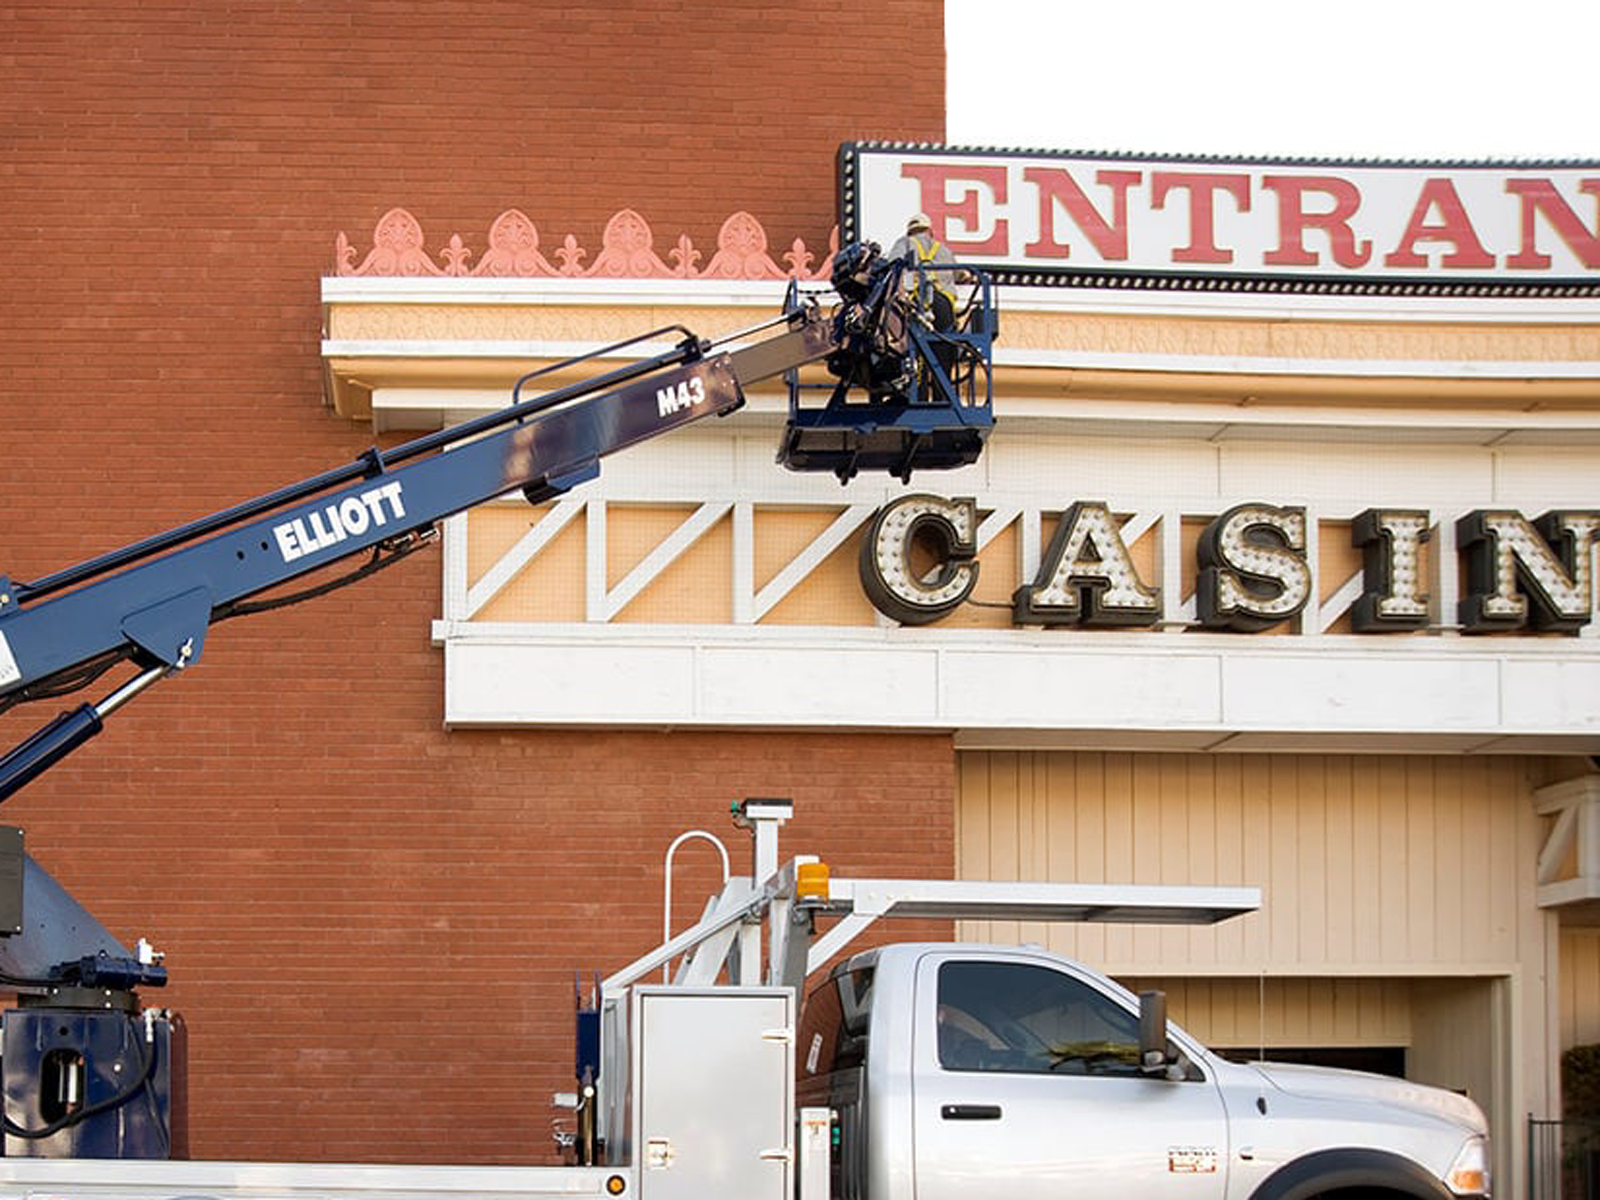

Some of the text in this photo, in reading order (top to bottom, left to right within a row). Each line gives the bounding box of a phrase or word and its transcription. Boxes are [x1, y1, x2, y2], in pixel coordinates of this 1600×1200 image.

[901, 162, 1600, 271] ENTRAN
[656, 376, 706, 418] M43
[273, 480, 406, 563] ELLIOTT
[859, 493, 1600, 635] CASIN
